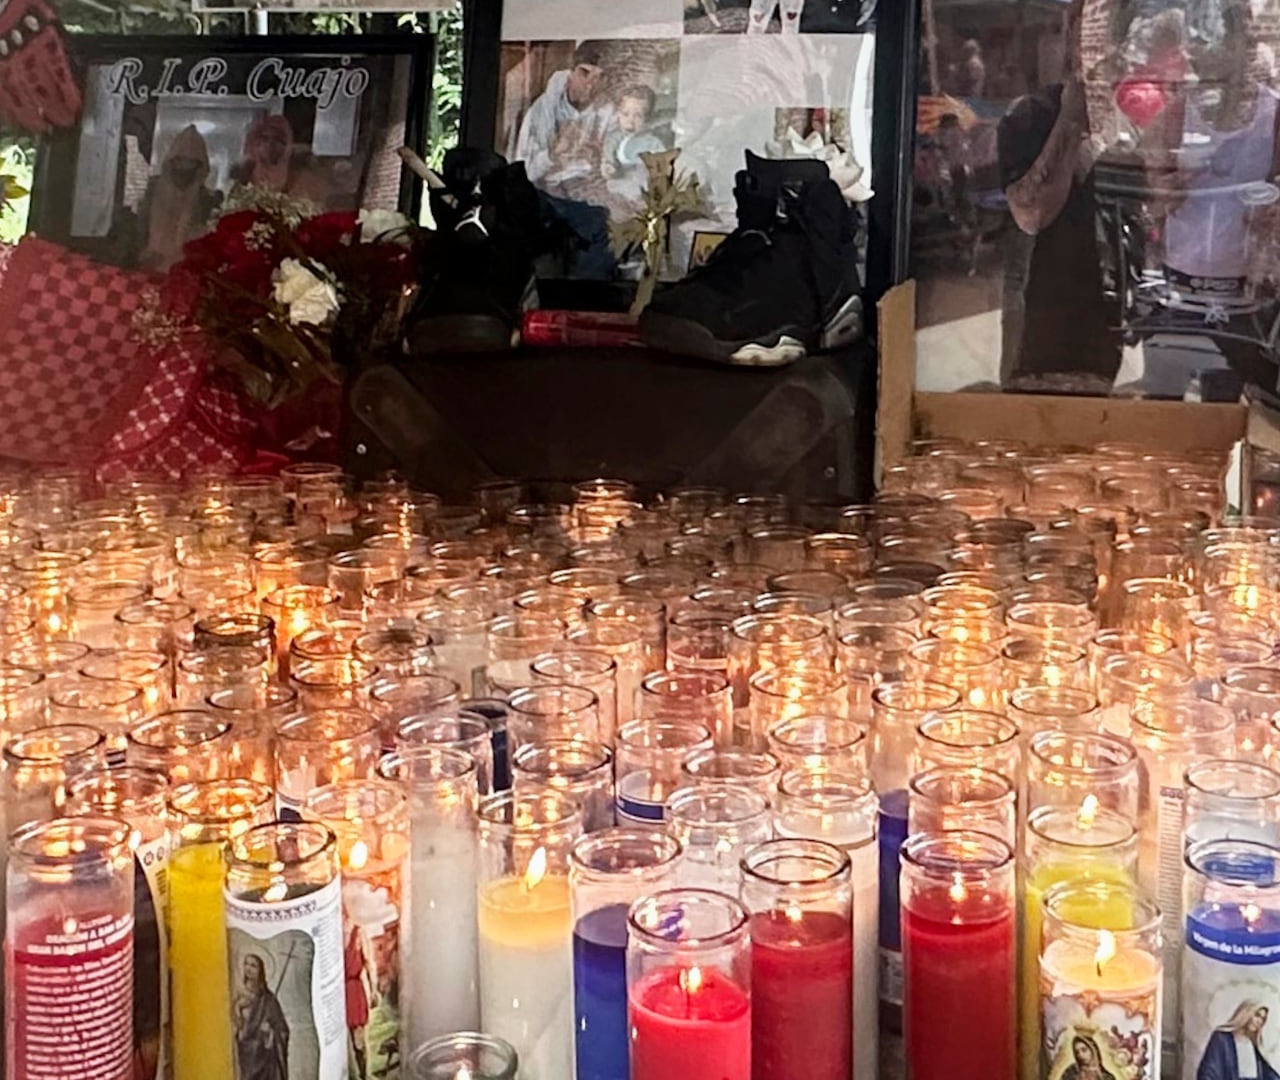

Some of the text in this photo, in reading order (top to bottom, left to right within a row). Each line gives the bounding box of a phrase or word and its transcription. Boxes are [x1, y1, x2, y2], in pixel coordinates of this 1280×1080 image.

[107, 56, 371, 110] R.I.P. Cuajo
[1192, 931, 1219, 950] Virgen
[1219, 941, 1232, 953] de
[1232, 943, 1243, 955] la
